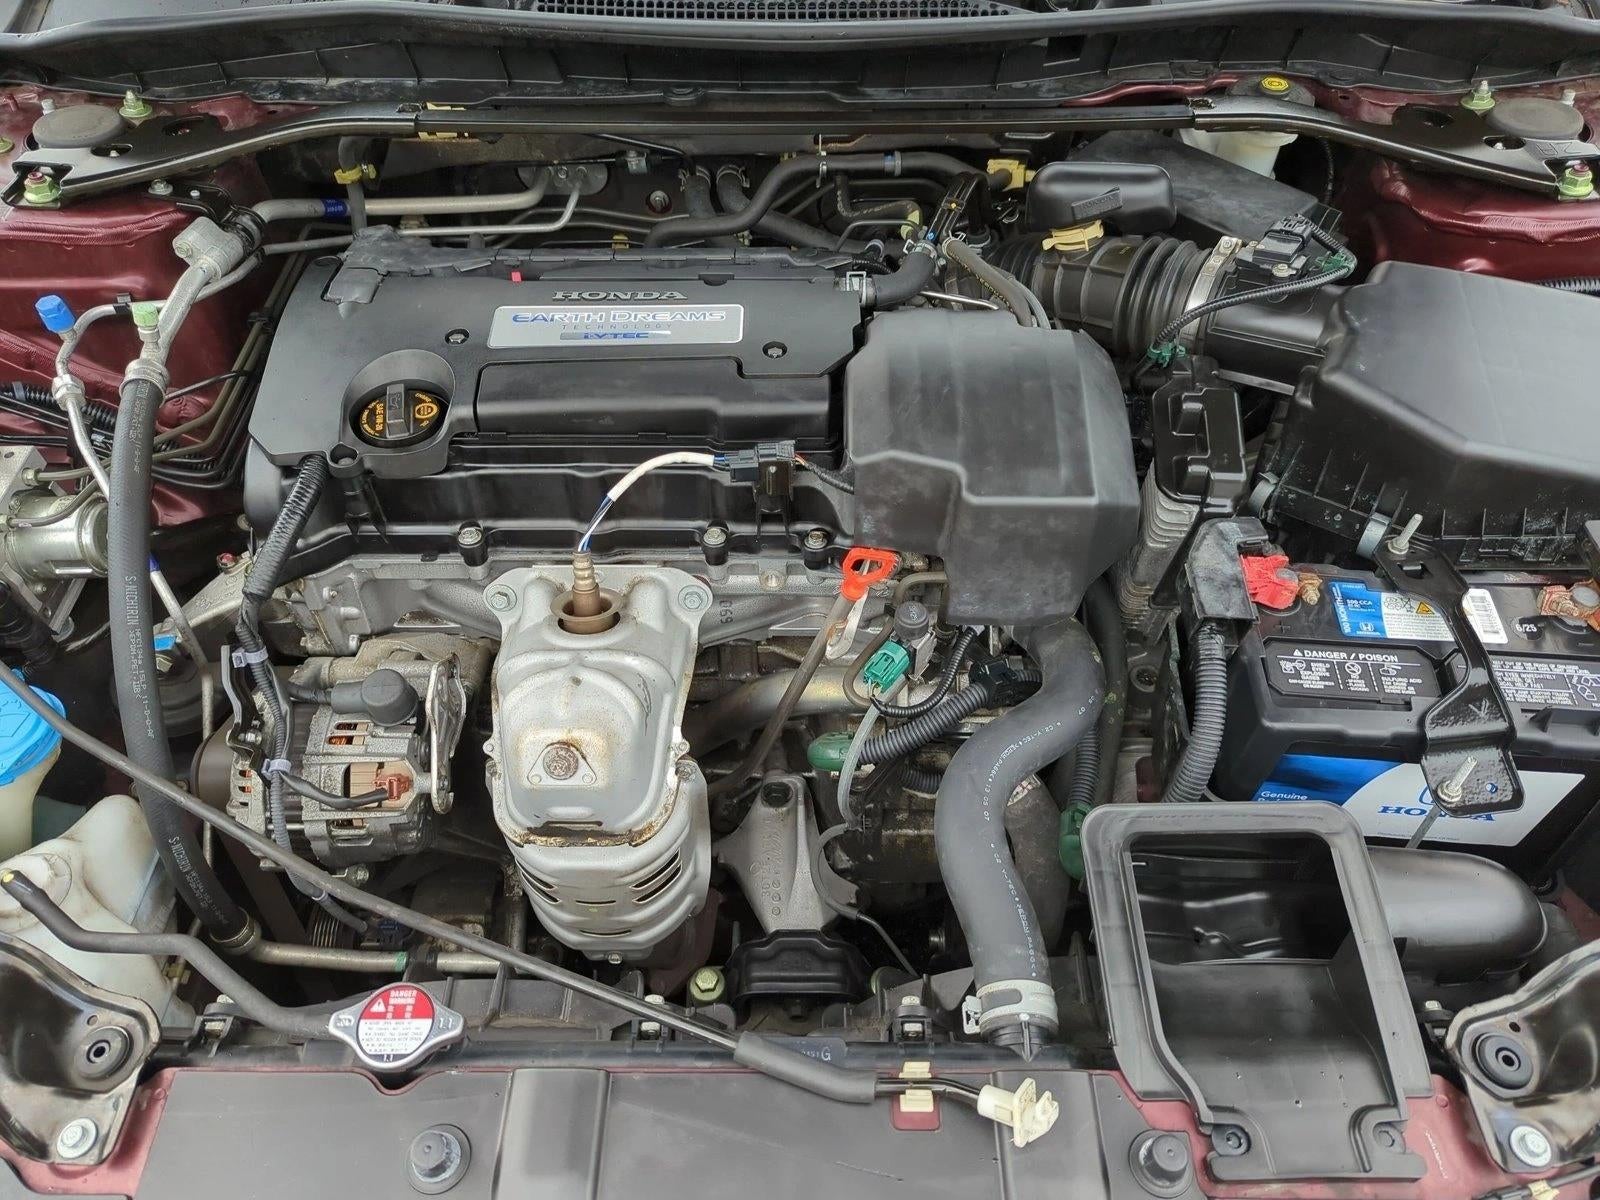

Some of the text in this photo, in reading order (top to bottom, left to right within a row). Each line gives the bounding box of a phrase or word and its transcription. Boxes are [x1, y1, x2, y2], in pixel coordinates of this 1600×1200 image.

[552, 291, 688, 301] HONDA
[512, 310, 727, 323] EARTH DREAMS
[1303, 650, 1347, 660] DANGER
[1358, 653, 1398, 662] POISON
[1260, 790, 1309, 801] Genuine
